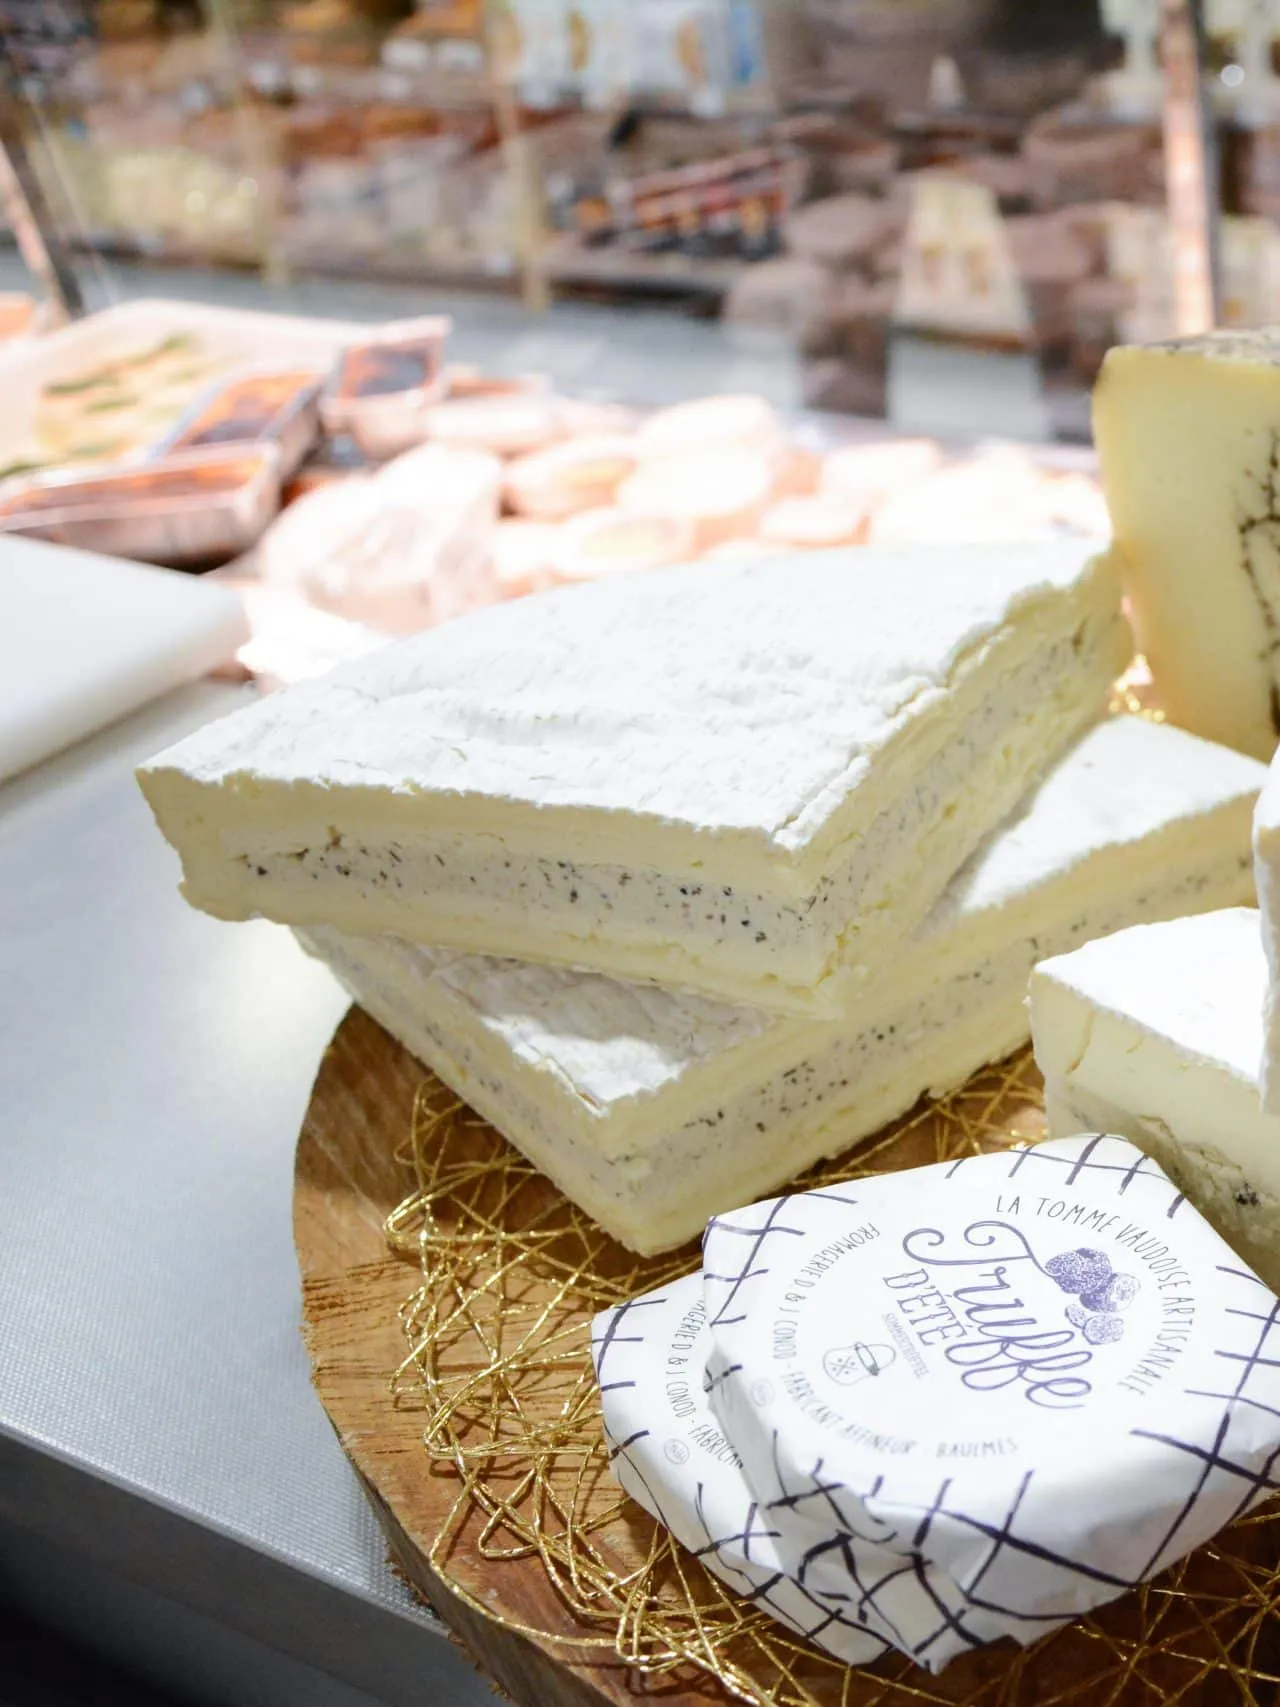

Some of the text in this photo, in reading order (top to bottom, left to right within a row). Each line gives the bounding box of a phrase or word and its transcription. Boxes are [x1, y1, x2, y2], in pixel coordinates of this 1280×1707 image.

[800, 1221, 881, 1279] FROMAGERIE
[902, 1220, 1093, 1409] Truffe
[996, 1194, 1195, 1396] LA TOMME VAUDOISE ARTISANALE
[773, 1319, 798, 1360] CONOD
[666, 1381, 697, 1418] CONOD
